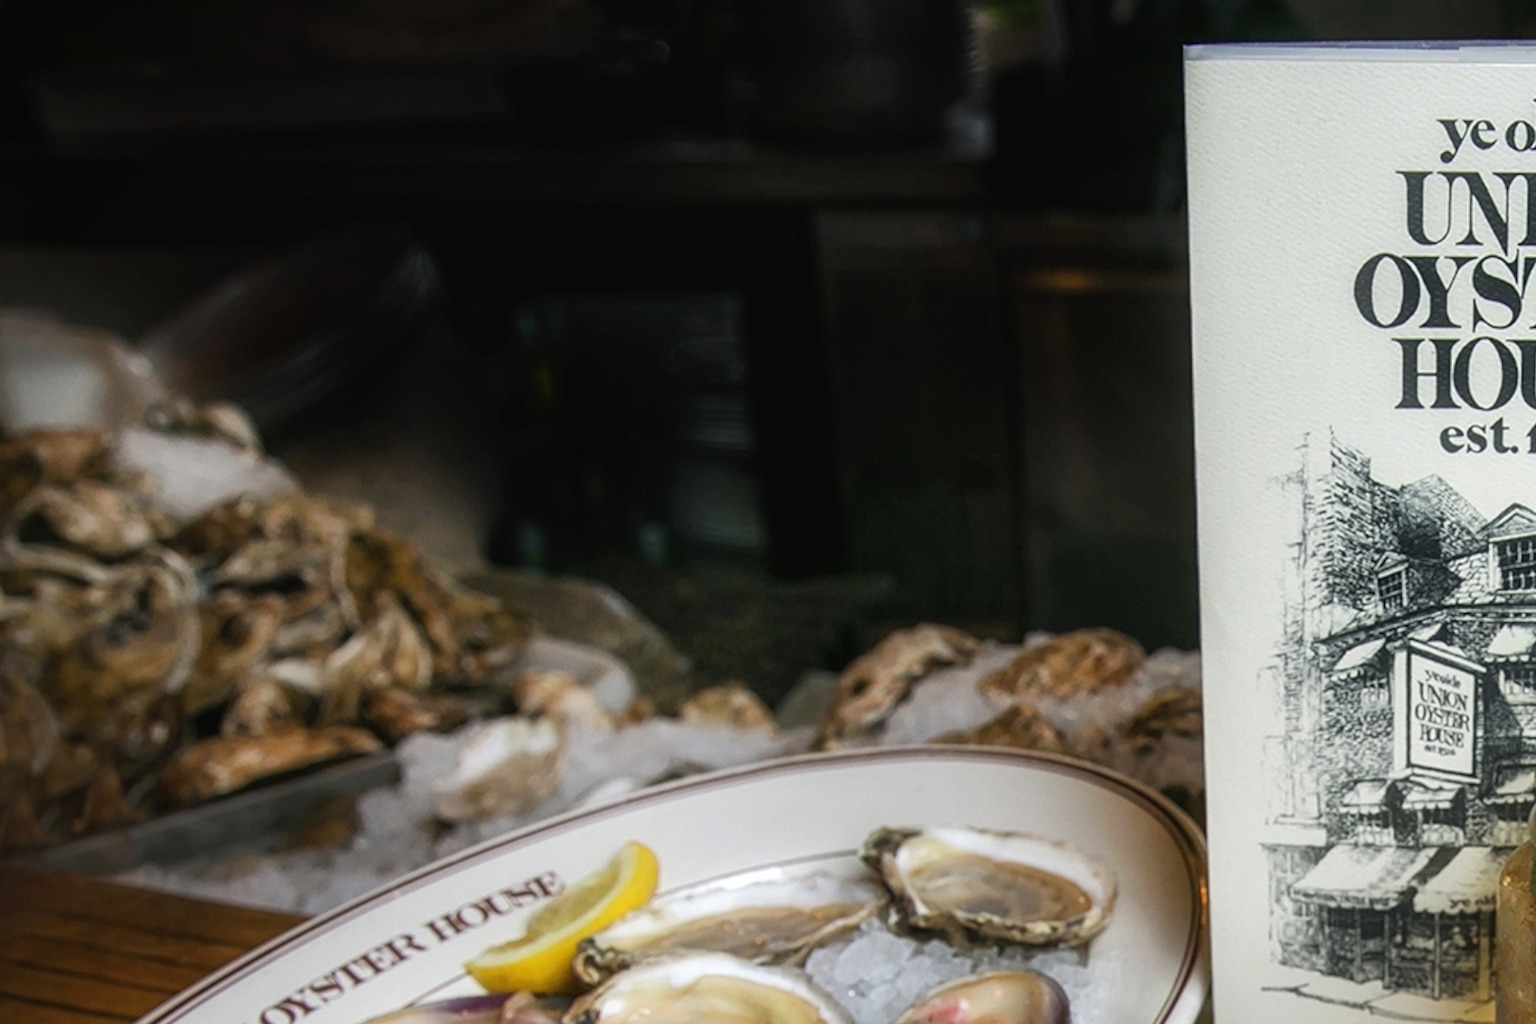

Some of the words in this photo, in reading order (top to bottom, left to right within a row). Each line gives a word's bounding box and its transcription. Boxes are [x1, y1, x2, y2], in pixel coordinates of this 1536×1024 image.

[1437, 117, 1496, 164] ye
[1439, 417, 1519, 456] est.
[1417, 680, 1469, 711] UNION
[1414, 703, 1471, 732] OYSTER
[1420, 722, 1465, 748] HOUSE
[424, 869, 568, 943] HOUSE
